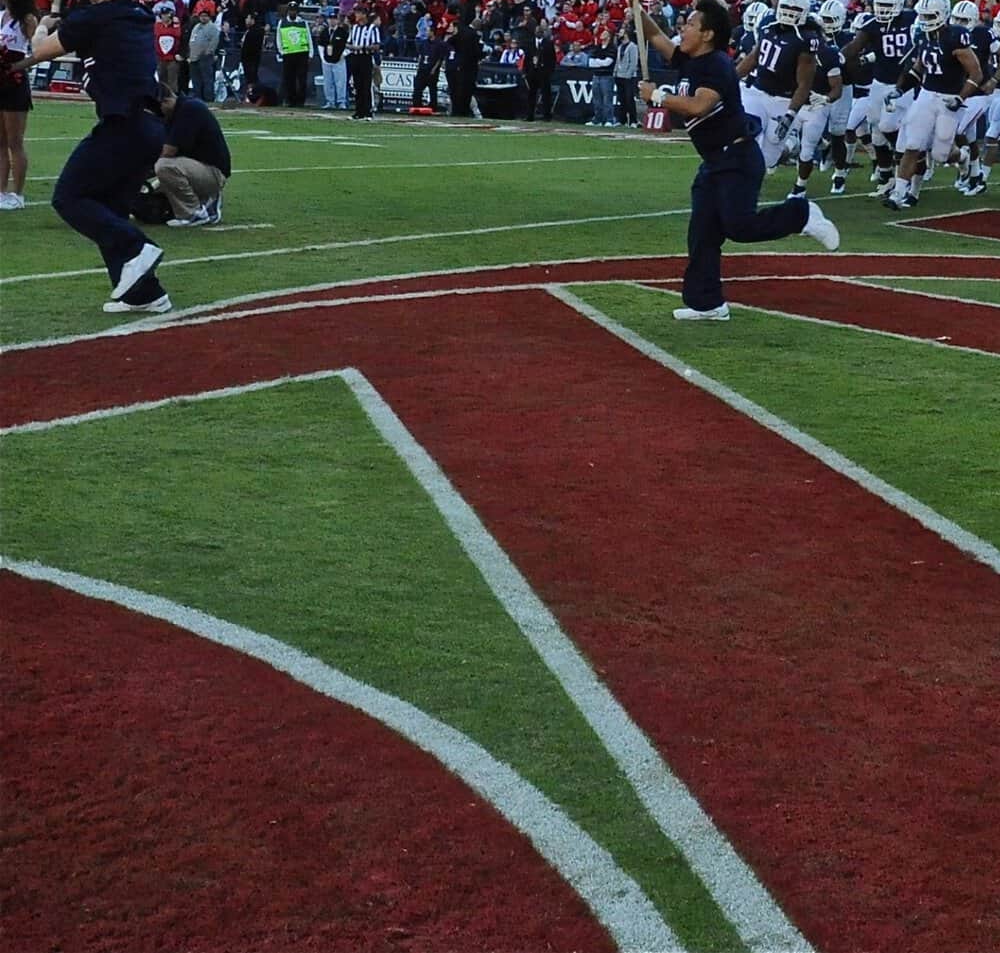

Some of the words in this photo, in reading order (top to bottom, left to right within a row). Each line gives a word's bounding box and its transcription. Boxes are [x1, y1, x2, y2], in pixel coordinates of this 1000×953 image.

[758, 39, 782, 72] 91
[882, 33, 908, 58] 69
[646, 111, 665, 129] 10
